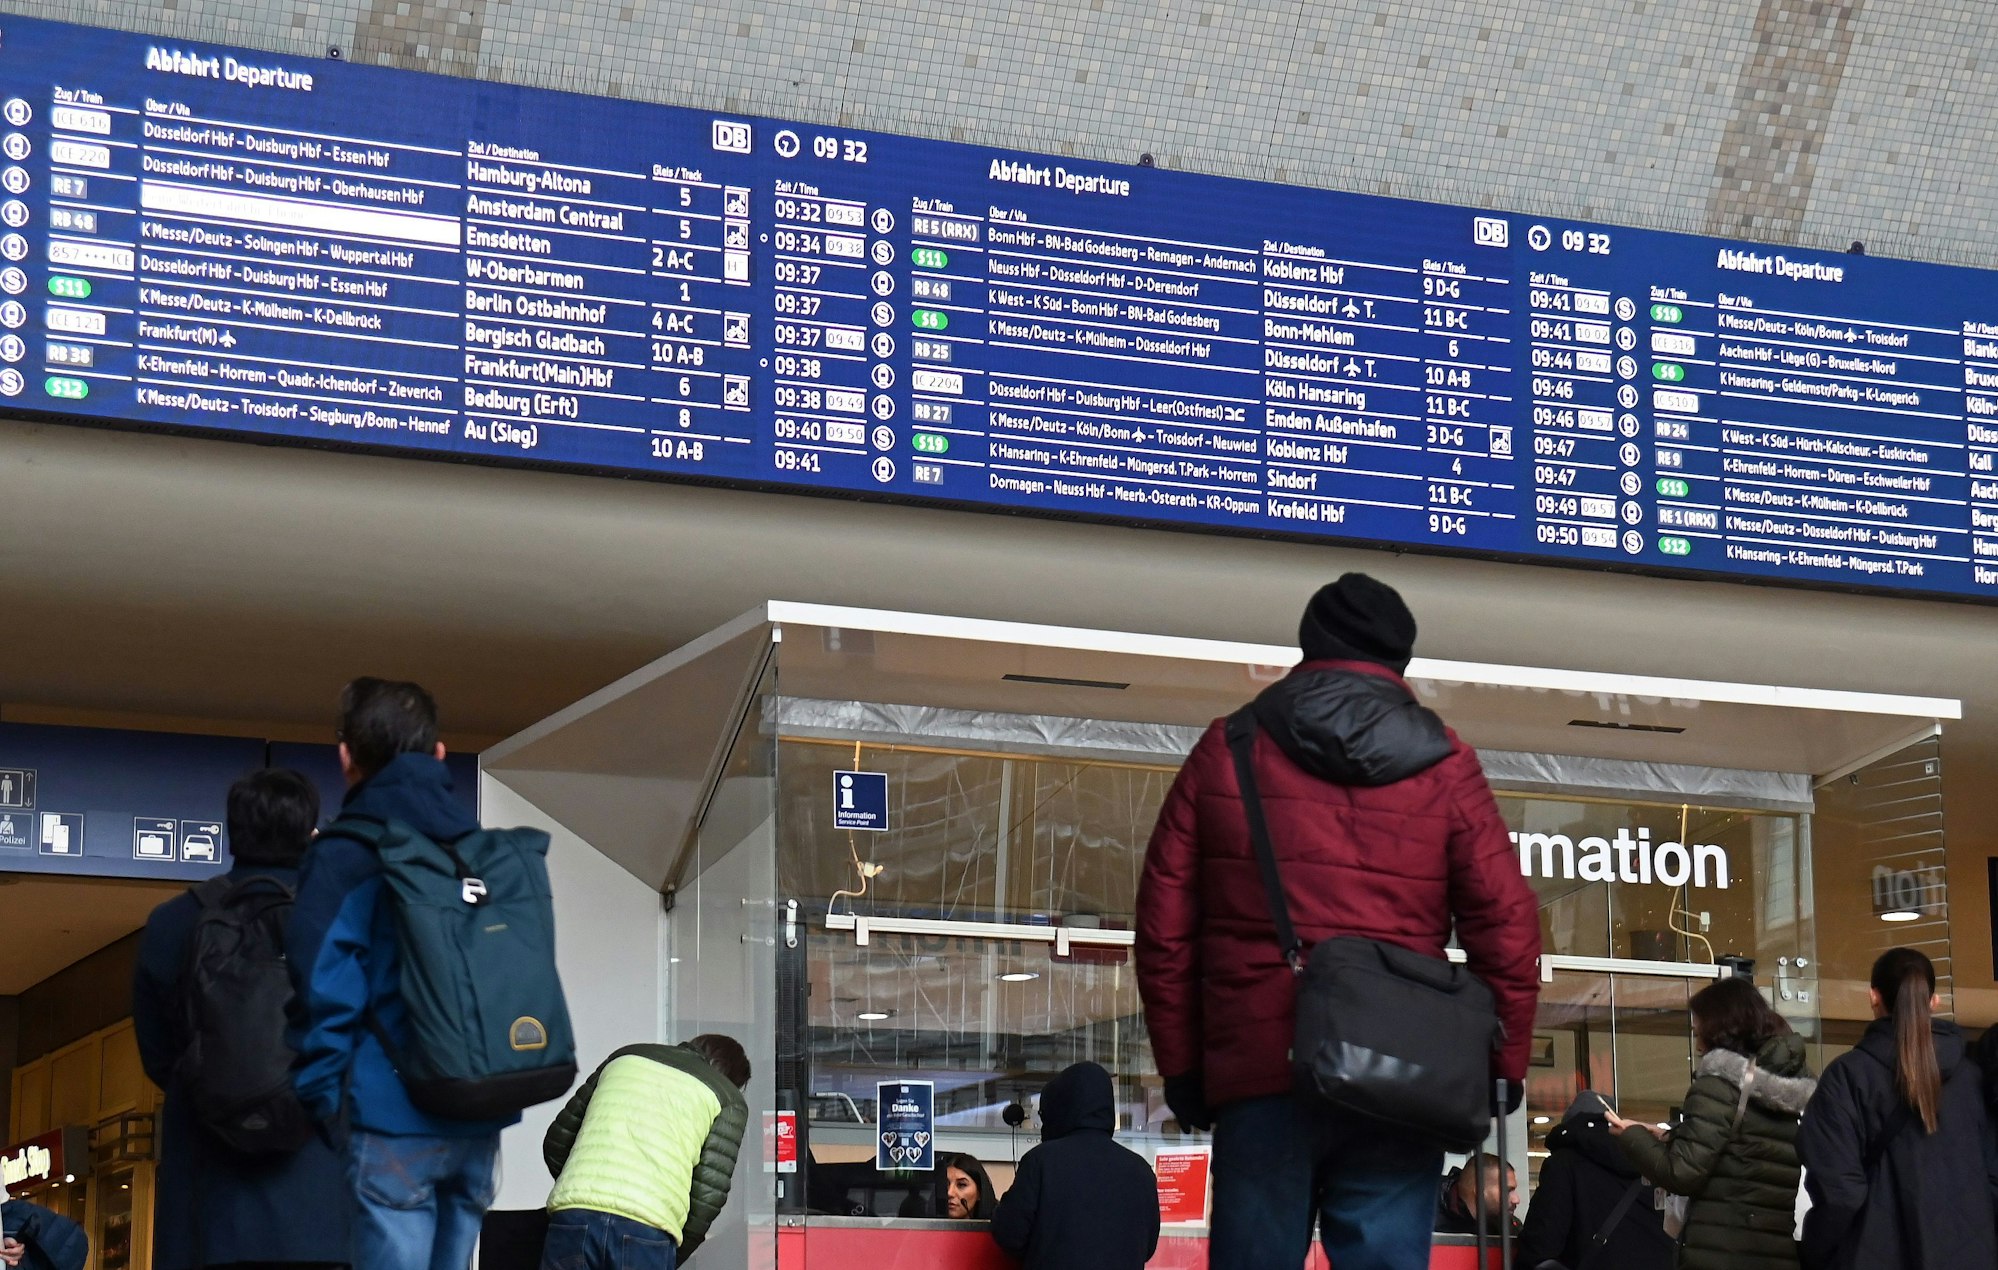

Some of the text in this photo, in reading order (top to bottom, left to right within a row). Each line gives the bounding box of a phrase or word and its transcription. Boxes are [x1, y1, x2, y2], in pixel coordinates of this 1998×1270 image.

[146, 47, 313, 91] Abfahrt Departure
[144, 121, 390, 167] Düsseldorf Hbf Duisburg Hbf Essen Hbf
[814, 136, 867, 163] 09 32
[54, 177, 84, 195] RE 7
[143, 155, 424, 205] Düsseldorf Hbf Duisburg Hbf Oberhausen Hbf
[468, 161, 591, 194] Hamburg-Altona
[989, 159, 1130, 196] Abfahrt Departure
[680, 187, 691, 206] 5
[467, 194, 623, 231] Amsterdam Centraal
[775, 199, 820, 222] 09:32
[466, 225, 551, 254] Emsdetten
[680, 219, 691, 239] 5
[775, 231, 820, 254] 09:34
[1562, 230, 1610, 255] 09 32
[652, 247, 693, 271] 2 A-C
[918, 250, 941, 267] S11
[1717, 249, 1843, 282] Abfahrt Departure
[466, 258, 584, 289] W-Oberbarmen
[775, 262, 820, 284] 09:37
[989, 259, 1199, 297] Neuss Hbf Düsseldorf Hbf D-Derendorf
[1264, 259, 1344, 284] Koblenz Hbf
[56, 279, 84, 297] S11
[680, 282, 690, 302] 1
[1423, 277, 1460, 298] 9 D-G
[466, 290, 606, 323] Berlin Ostbahnhof
[775, 293, 820, 315] 09:37
[1264, 289, 1375, 319] Düsseldorf T.
[1530, 290, 1570, 311] 09:41
[652, 311, 693, 333] 4 A-C
[922, 312, 938, 327] S6
[1424, 308, 1468, 329] 11 B-C
[1656, 306, 1678, 321] S19
[466, 322, 604, 355] Bergisch Gladbach
[775, 324, 820, 346] 09:37
[1265, 319, 1354, 346] Bonn-Mehlem
[1531, 320, 1571, 341] 09:41
[652, 342, 704, 366] 10 A-B
[1449, 340, 1459, 357] 6
[1532, 349, 1572, 370] 09:44
[775, 356, 820, 378] 09:38
[1265, 349, 1377, 378] Düsseldorf T.
[1661, 365, 1675, 379] S6
[138, 354, 208, 377] K-Ehrenfeld
[219, 363, 266, 383] Horrem
[388, 381, 442, 401] Zieverich
[680, 377, 690, 396] 6
[1426, 366, 1471, 388] 10 A-B
[53, 379, 82, 398] S12
[775, 387, 820, 409] 09:38
[990, 381, 1045, 400] Düsseldorf
[1047, 387, 1066, 403] Hbf
[1076, 390, 1120, 411] Duisburg
[1122, 395, 1140, 411] Hbf
[1266, 379, 1365, 410] Köln Hansaring
[1533, 378, 1573, 399] 09:46
[465, 387, 578, 418] Bedburg (Erft)
[1426, 396, 1470, 417] 11 B-C
[679, 409, 690, 428] 8
[1266, 408, 1396, 439] Emden Außenhafen
[1534, 407, 1574, 428] 09:46
[464, 419, 538, 449] Au (Sieg)
[775, 418, 821, 441] 09:40
[1427, 425, 1463, 446] 3 D-G
[652, 438, 703, 461] 10 A-B
[919, 435, 943, 451] S19
[1267, 438, 1347, 464] Koblenz Hbf
[1534, 437, 1575, 457] 09:47
[775, 450, 820, 472] 09:41
[1452, 458, 1462, 475] 4
[1969, 452, 1992, 471] Kall
[916, 466, 940, 481] RE 7
[1267, 469, 1317, 490] Sindorf
[1535, 466, 1576, 486] 09:47
[1723, 458, 1930, 491] K-Ehrenfeld Horrem Düren Eschweiler Hbf
[990, 473, 1044, 494] Dormagen
[1054, 480, 1084, 496] Neuss
[1086, 483, 1105, 498] Hbf
[1206, 495, 1259, 514] KR-Oppum
[1428, 485, 1472, 506] 11 B-C
[1662, 480, 1683, 495] S11
[1268, 499, 1345, 523] Krefeld Hbf
[1536, 495, 1577, 516] 09:49
[1429, 514, 1466, 535] 9 D-G
[1537, 525, 1578, 545] 09:50
[1664, 538, 1686, 554] S12
[838, 810, 876, 820] Information
[892, 1103, 919, 1113] Danke
